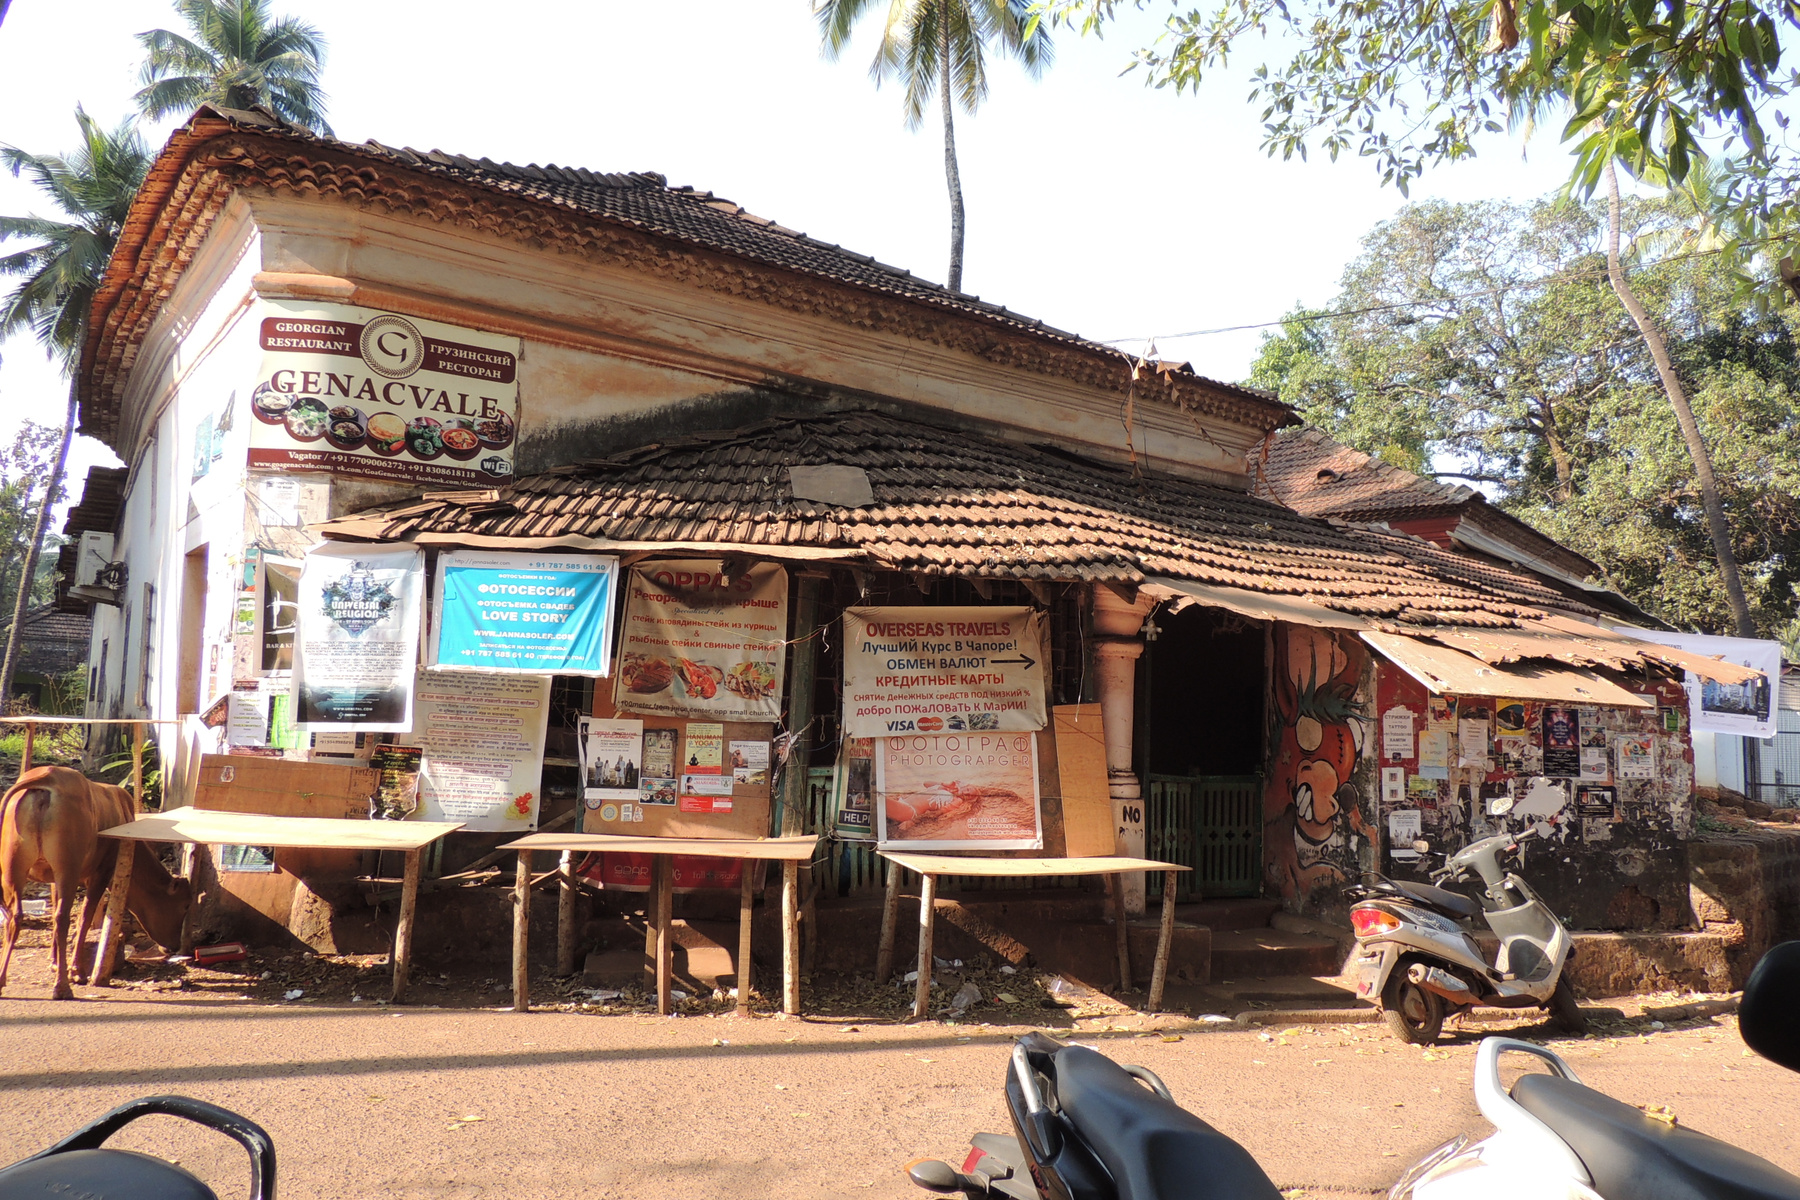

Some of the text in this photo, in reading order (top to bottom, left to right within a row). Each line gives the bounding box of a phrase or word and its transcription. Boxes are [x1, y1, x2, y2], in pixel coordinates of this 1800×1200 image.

[275, 322, 346, 336] GEORGIAN
[267, 337, 352, 352] RESTAURANT
[430, 344, 512, 367] ГРУЗИНСКИЙ
[438, 360, 502, 379] РЕСТОРАН
[271, 369, 501, 421] GENACVALE
[288, 451, 322, 461] Vagator
[324, 453, 329, 461] /
[331, 454, 348, 463] +91
[408, 464, 426, 473] +91
[426, 465, 476, 479] 8308618118
[566, 562, 581, 570] 585
[477, 583, 576, 597] ФОТОСЕССИИ
[332, 601, 380, 610] UNIVERSAL
[477, 600, 575, 611] ФОТОСЪЕМКА СВАДЕБ
[736, 597, 779, 609] крыше
[333, 609, 380, 619] RELIGION
[482, 610, 569, 624] LOVE STORY
[632, 614, 655, 624] стейк
[705, 619, 729, 628] стейк
[744, 623, 778, 632] курицы
[866, 622, 1011, 637] OVERSEAS TRAVELS
[694, 630, 700, 638] &
[629, 634, 776, 652] рыбные стейки свиные стейки
[922, 641, 951, 654] Курс
[955, 641, 963, 652] В
[966, 639, 1018, 653] Чапоре!
[887, 657, 987, 670] ОБМЕН ВАЛЮТ
[876, 673, 1004, 689] КРЕДИТНЫЕ КАРТЫ
[714, 708, 728, 716] opp
[749, 709, 773, 717] church
[856, 704, 891, 717] добро
[973, 702, 980, 712] К
[886, 720, 915, 732] VISA
[889, 735, 1029, 752] ФОТОГРАФ
[890, 754, 1030, 767] PHOTOGRAPGER
[1123, 805, 1141, 824] NO
